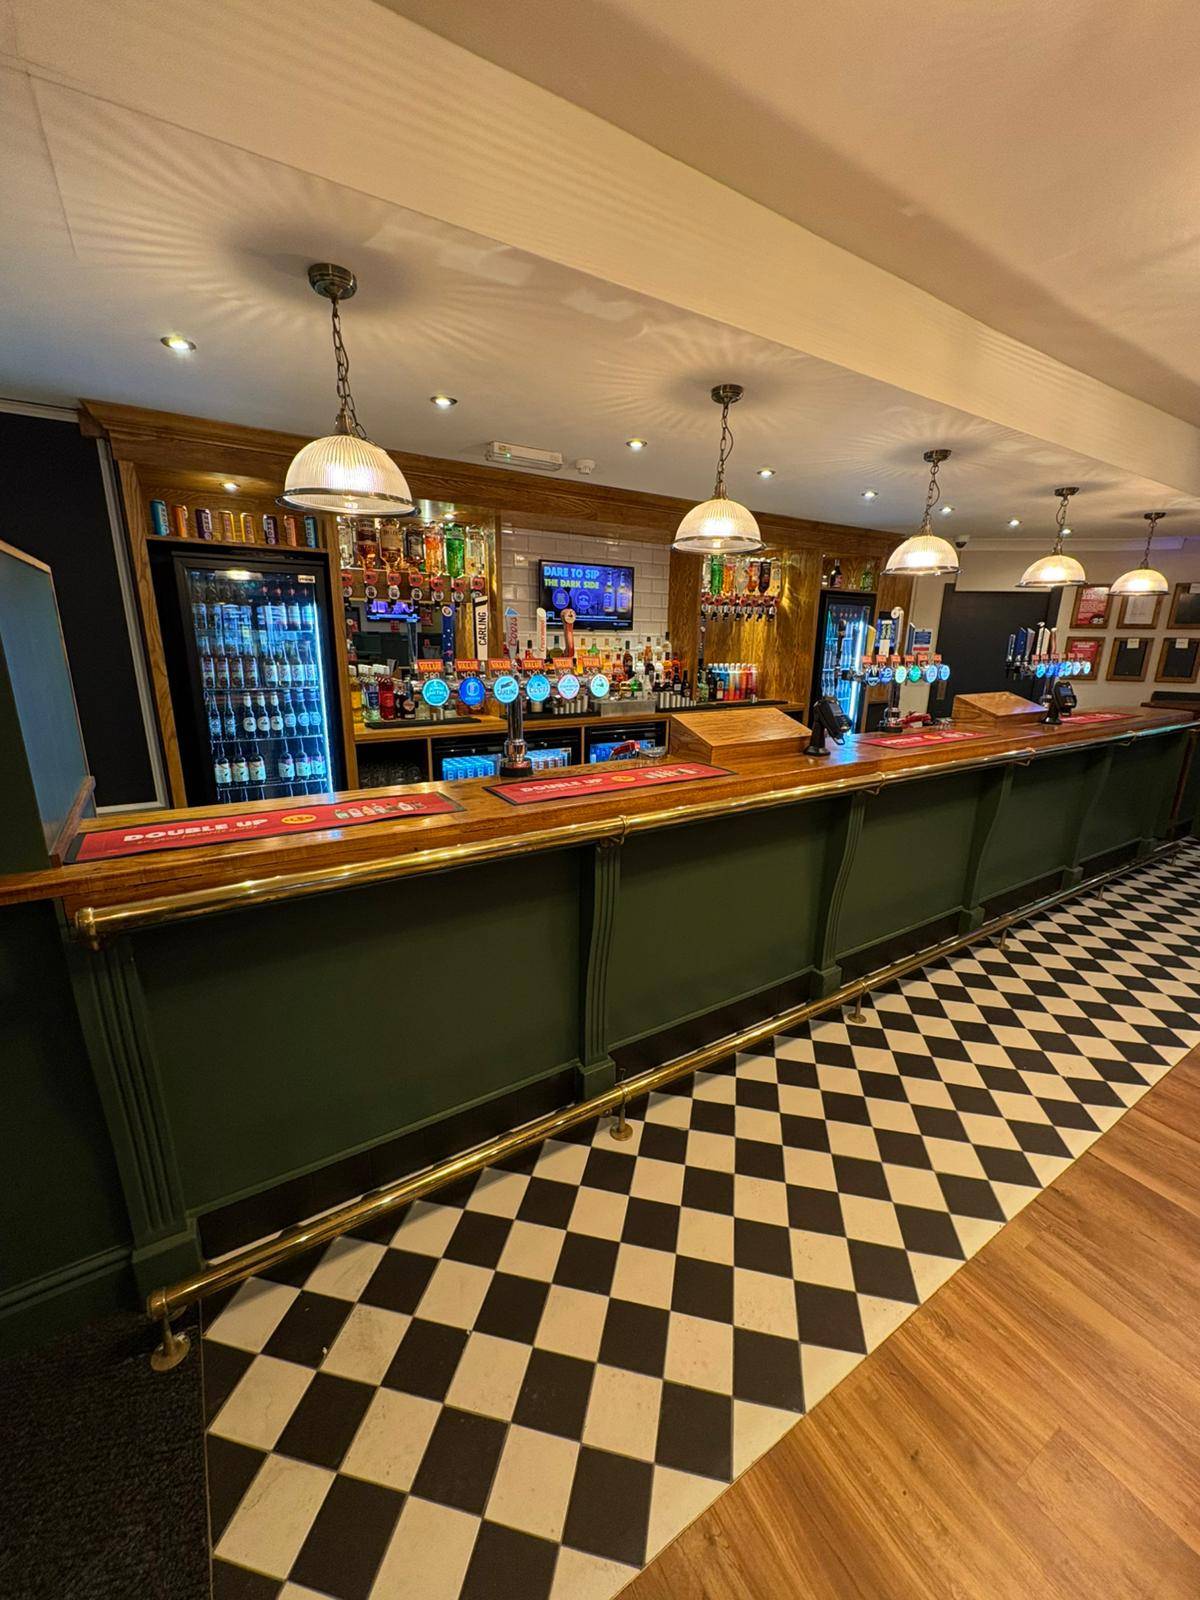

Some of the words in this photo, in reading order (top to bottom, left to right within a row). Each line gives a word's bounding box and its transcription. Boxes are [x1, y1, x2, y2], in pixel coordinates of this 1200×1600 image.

[543, 566, 569, 578] DARE
[570, 568, 584, 578] TO
[584, 569, 600, 580] SIP
[543, 578, 559, 587] THE
[560, 579, 581, 589] DARK
[582, 580, 600, 589] SIDE
[478, 611, 487, 646] CARLING
[456, 661, 479, 669] VALUE
[520, 781, 581, 792] DOUBLE
[123, 823, 229, 842] DOUBLE
[236, 819, 268, 828] UP
